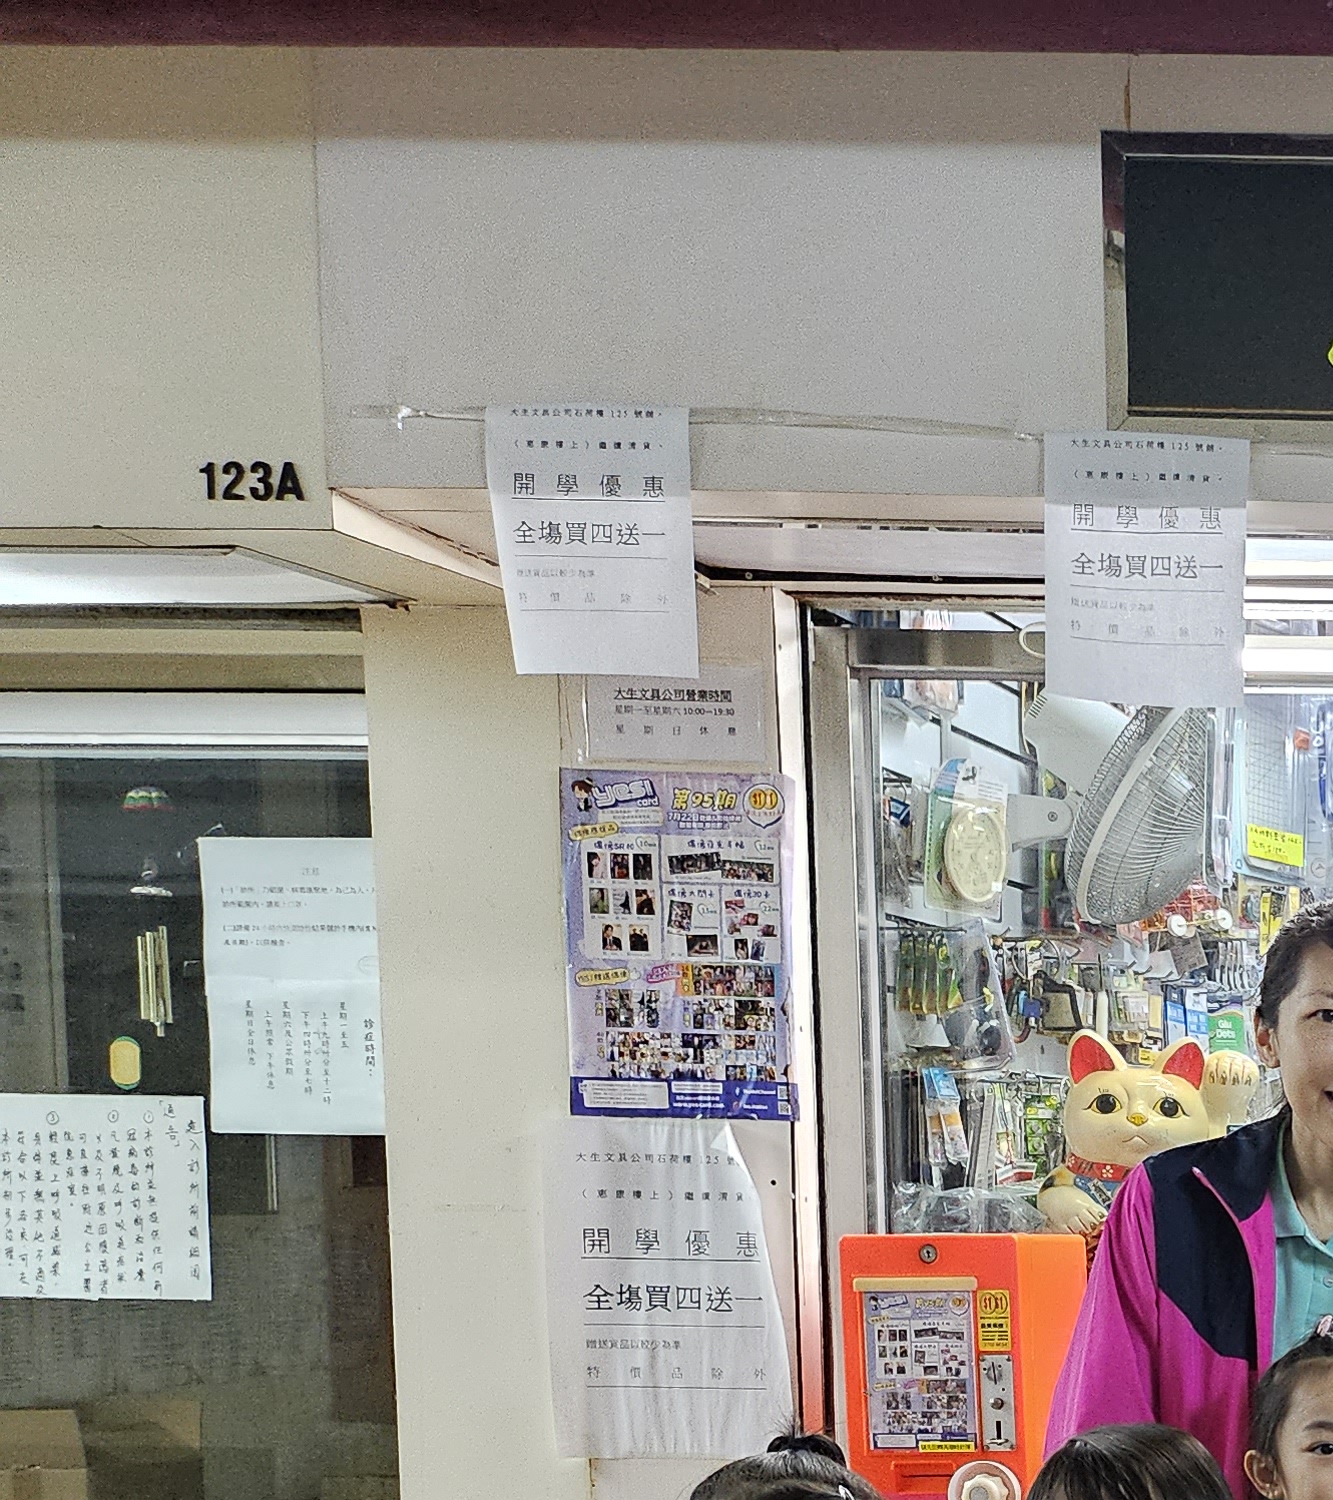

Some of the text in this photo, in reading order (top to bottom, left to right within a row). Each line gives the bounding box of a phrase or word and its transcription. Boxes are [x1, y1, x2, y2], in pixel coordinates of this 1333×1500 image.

[199, 461, 305, 502] 123A
[513, 473, 665, 497] 開學優惠
[1072, 503, 1222, 529] 開學優惠
[582, 1228, 760, 1256] 開學優惠
